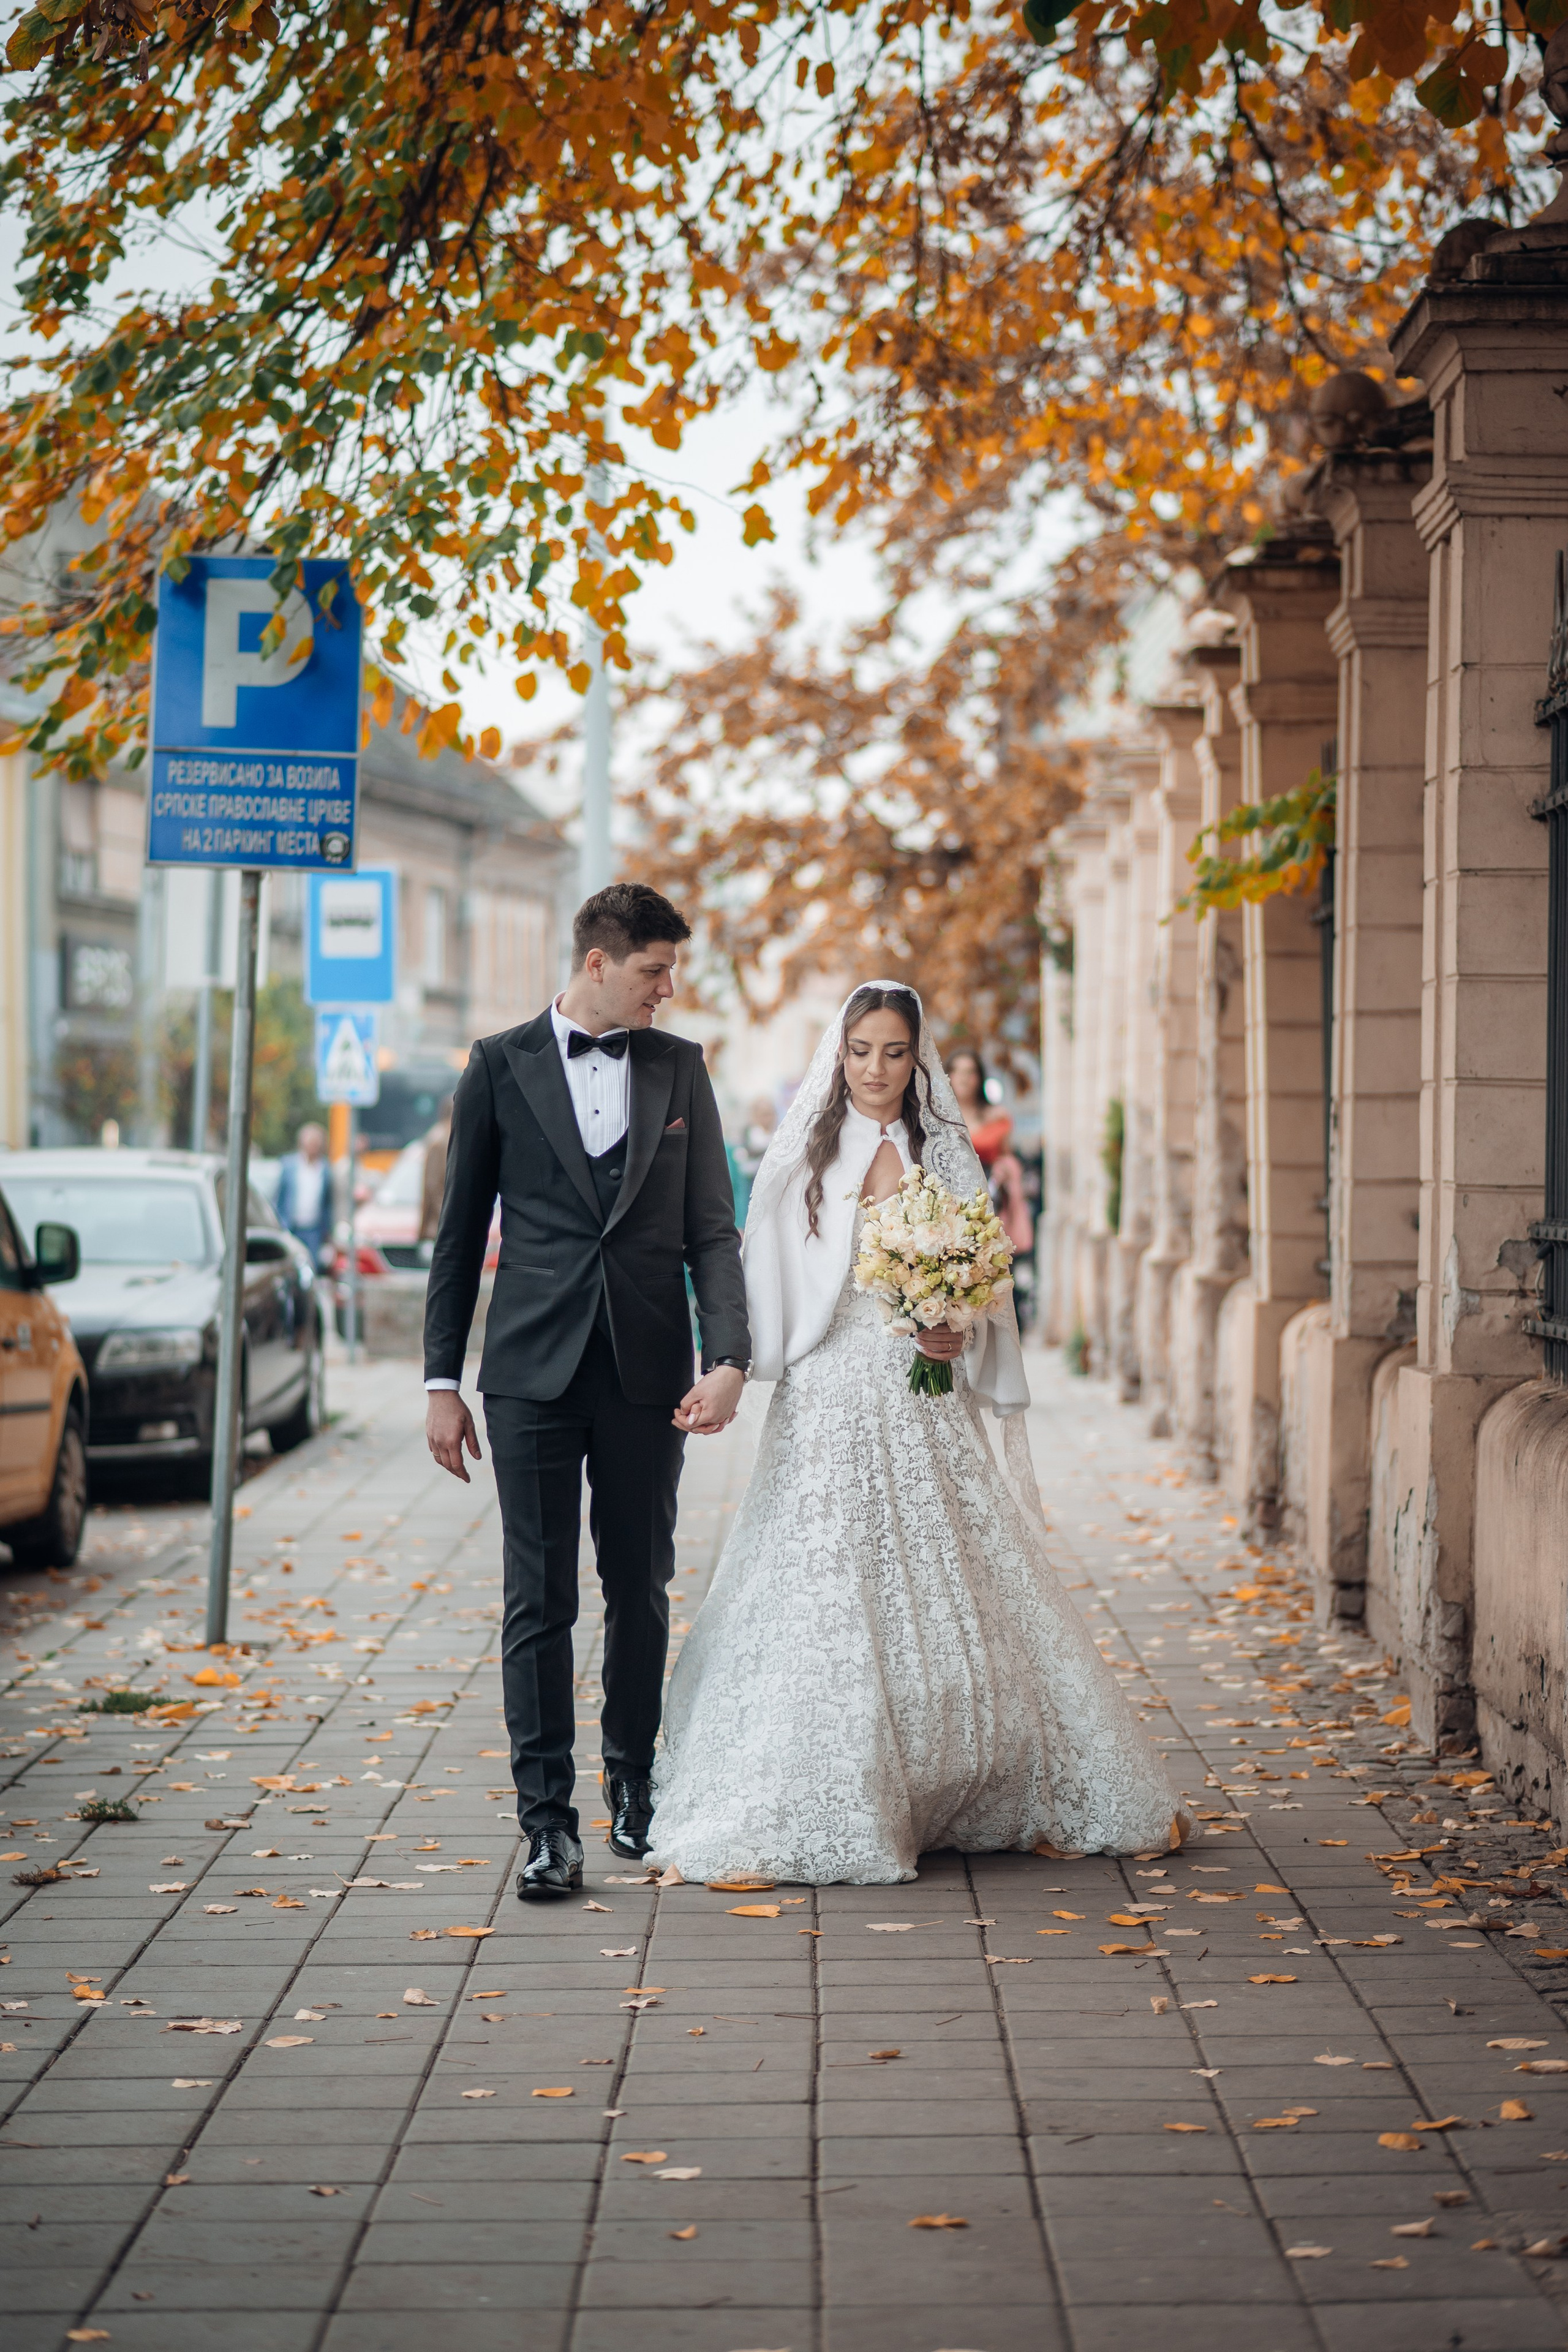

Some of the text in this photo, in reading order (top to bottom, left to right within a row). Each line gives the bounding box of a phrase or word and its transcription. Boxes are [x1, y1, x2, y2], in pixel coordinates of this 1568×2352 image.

[202, 578, 314, 728] P
[168, 760, 341, 791] РЕЗЕРВИСАНО ЗА ВОЗИЛА
[155, 793, 352, 827] СРПСКЕ ПРАВОСЛАВНЕ ЦРКВЕ
[182, 827, 321, 856] НА 2 ПАРКИНГ МЕСТА
